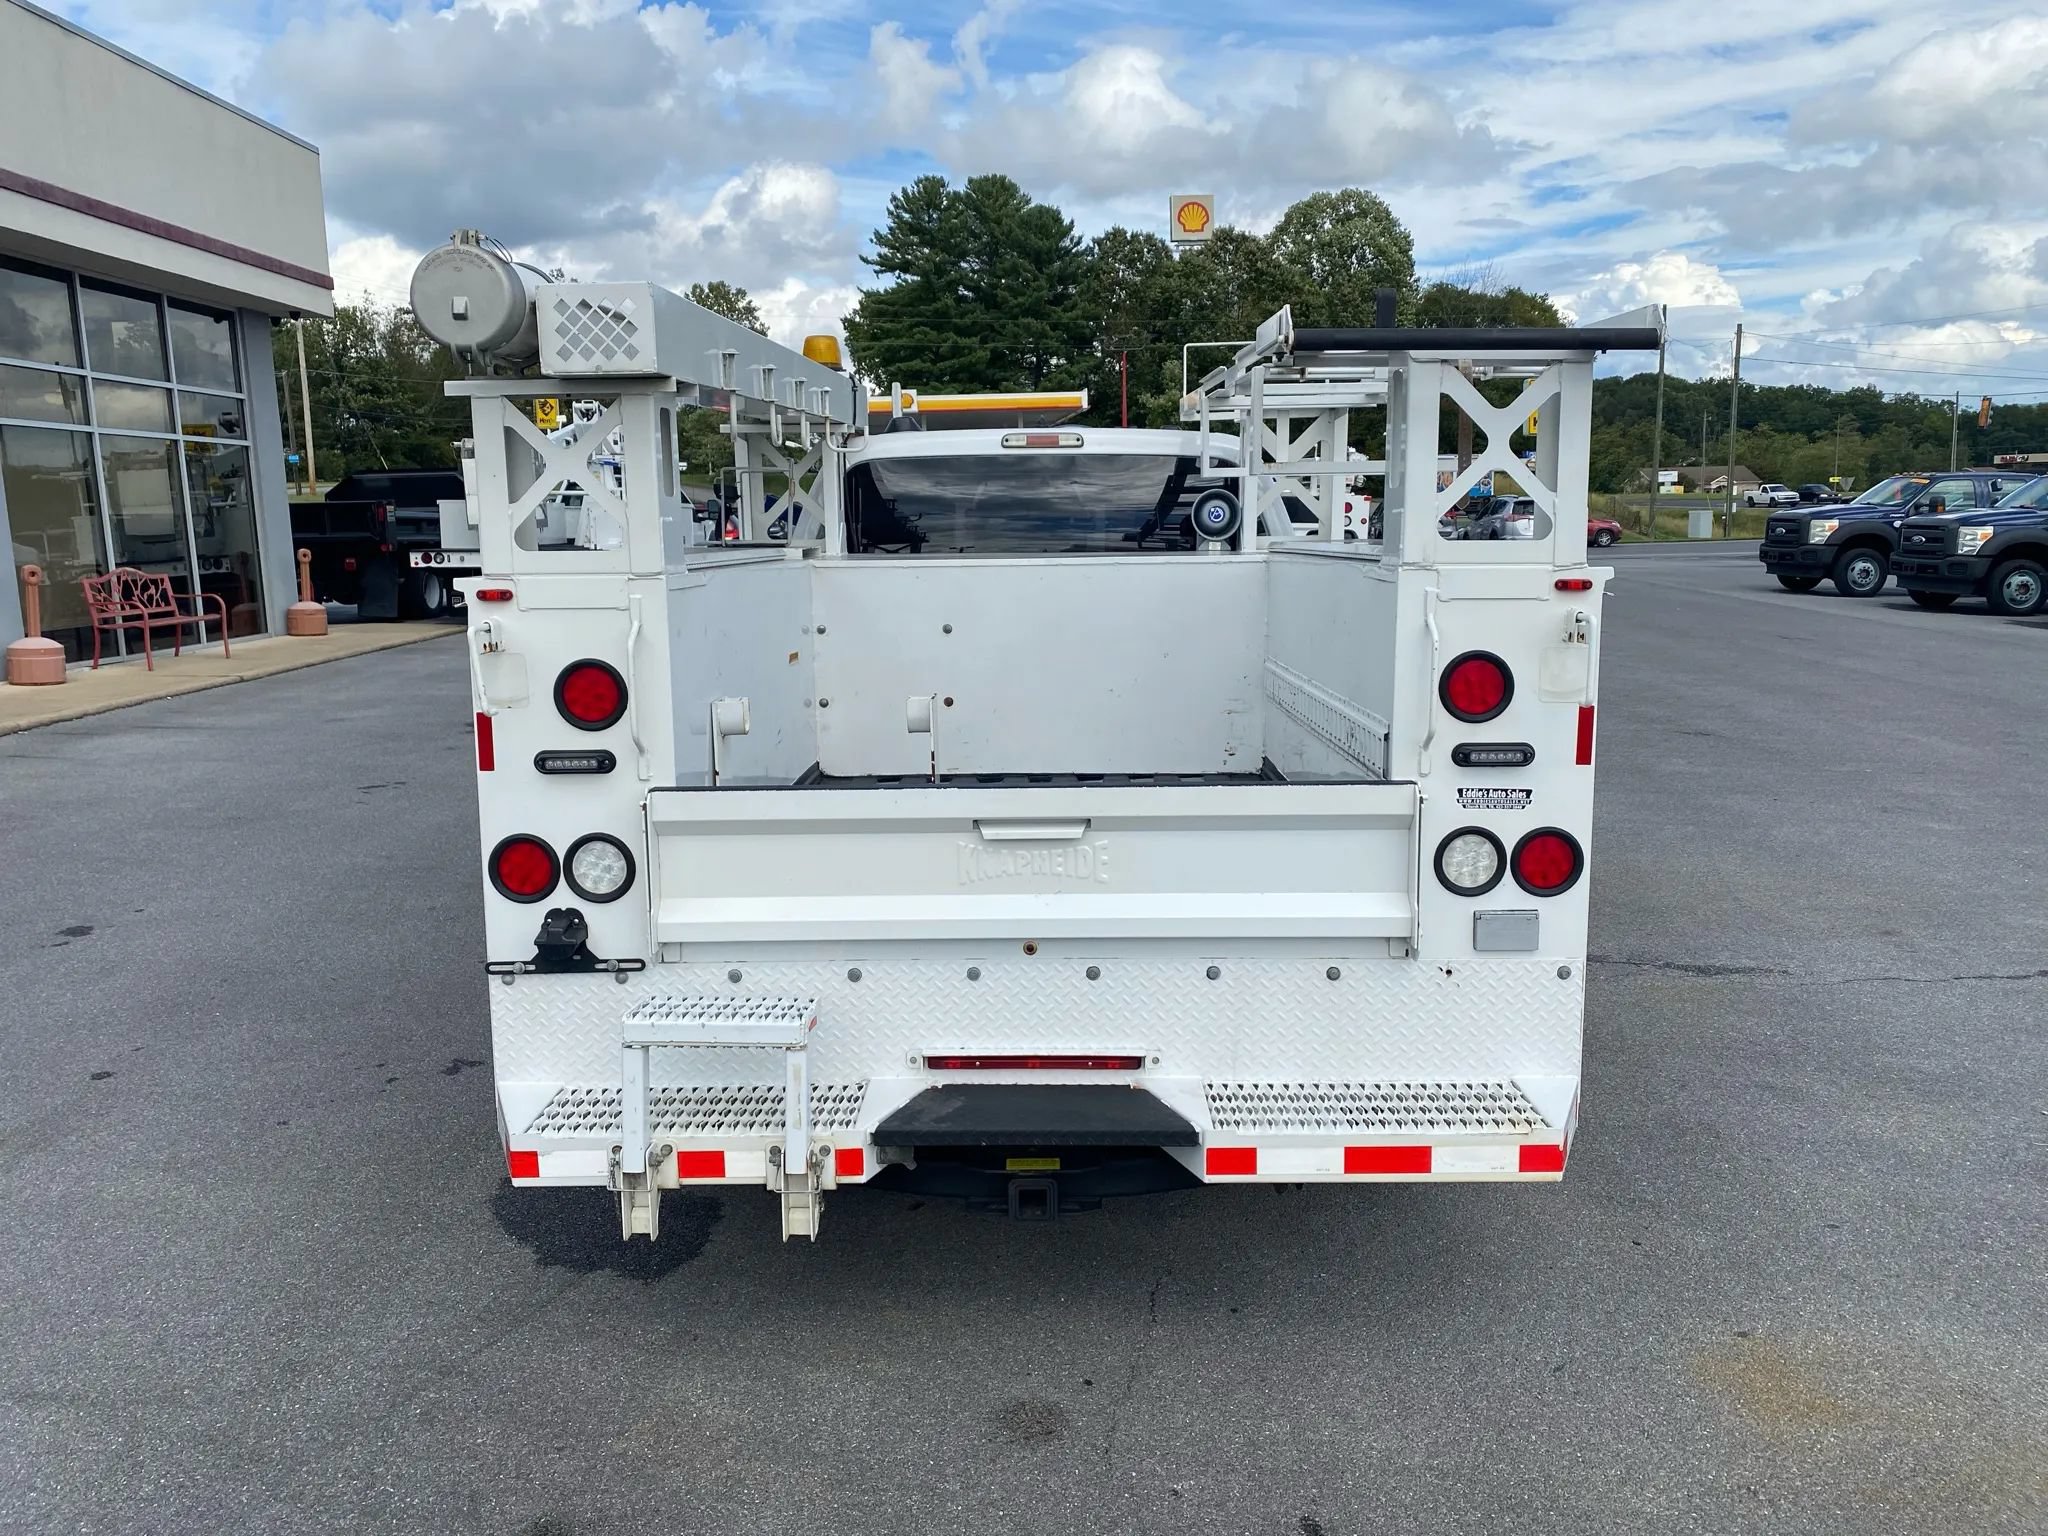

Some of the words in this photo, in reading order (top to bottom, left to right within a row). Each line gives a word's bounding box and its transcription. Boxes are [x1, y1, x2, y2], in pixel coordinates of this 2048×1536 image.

[1462, 788, 1487, 798] Eddie's
[1488, 789, 1506, 798] Auto
[1507, 789, 1527, 799] Sales
